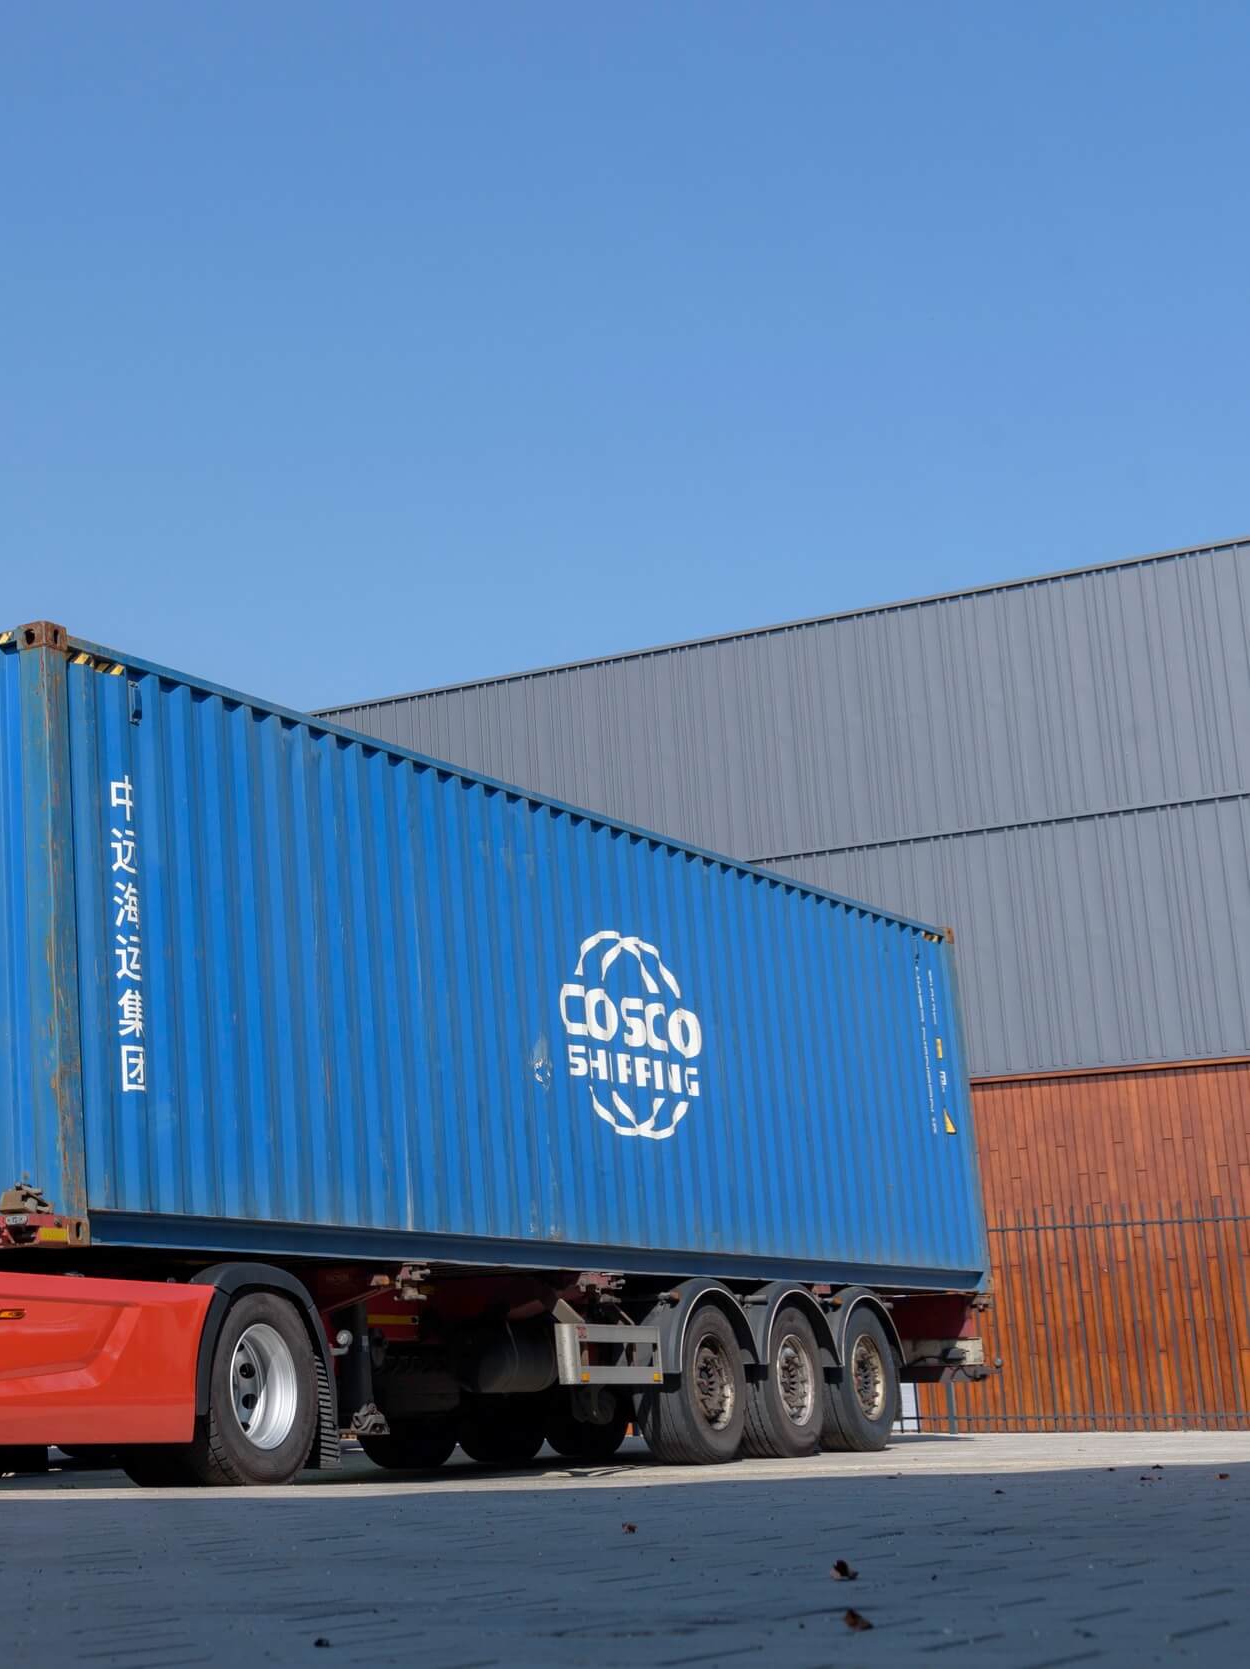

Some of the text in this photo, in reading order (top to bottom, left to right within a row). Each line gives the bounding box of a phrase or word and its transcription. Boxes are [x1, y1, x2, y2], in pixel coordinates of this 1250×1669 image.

[110, 775, 147, 1092] 中远海运集团
[559, 983, 703, 1059] COSCO
[568, 1044, 701, 1097] SHIPPING
